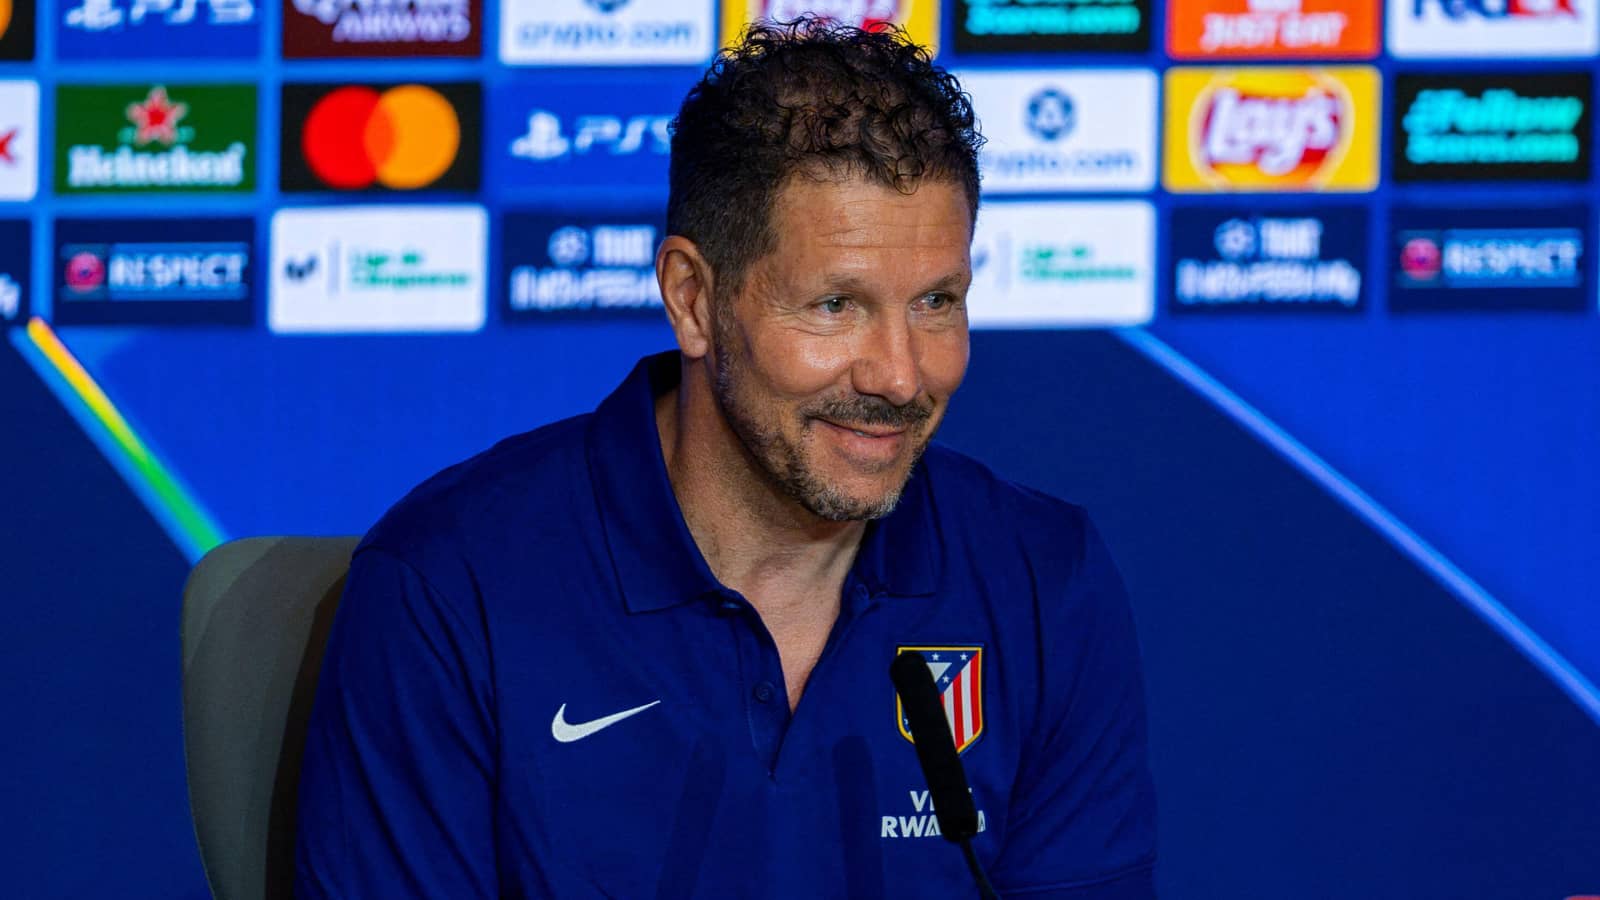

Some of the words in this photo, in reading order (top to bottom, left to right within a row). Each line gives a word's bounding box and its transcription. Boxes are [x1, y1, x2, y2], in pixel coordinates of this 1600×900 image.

[1200, 12, 1278, 51] JUST
[1279, 12, 1348, 47] EAT
[68, 143, 246, 188] Heineken
[108, 252, 248, 287] RESPECT
[1444, 239, 1582, 277] RESPECT
[881, 811, 986, 838] RWAA
